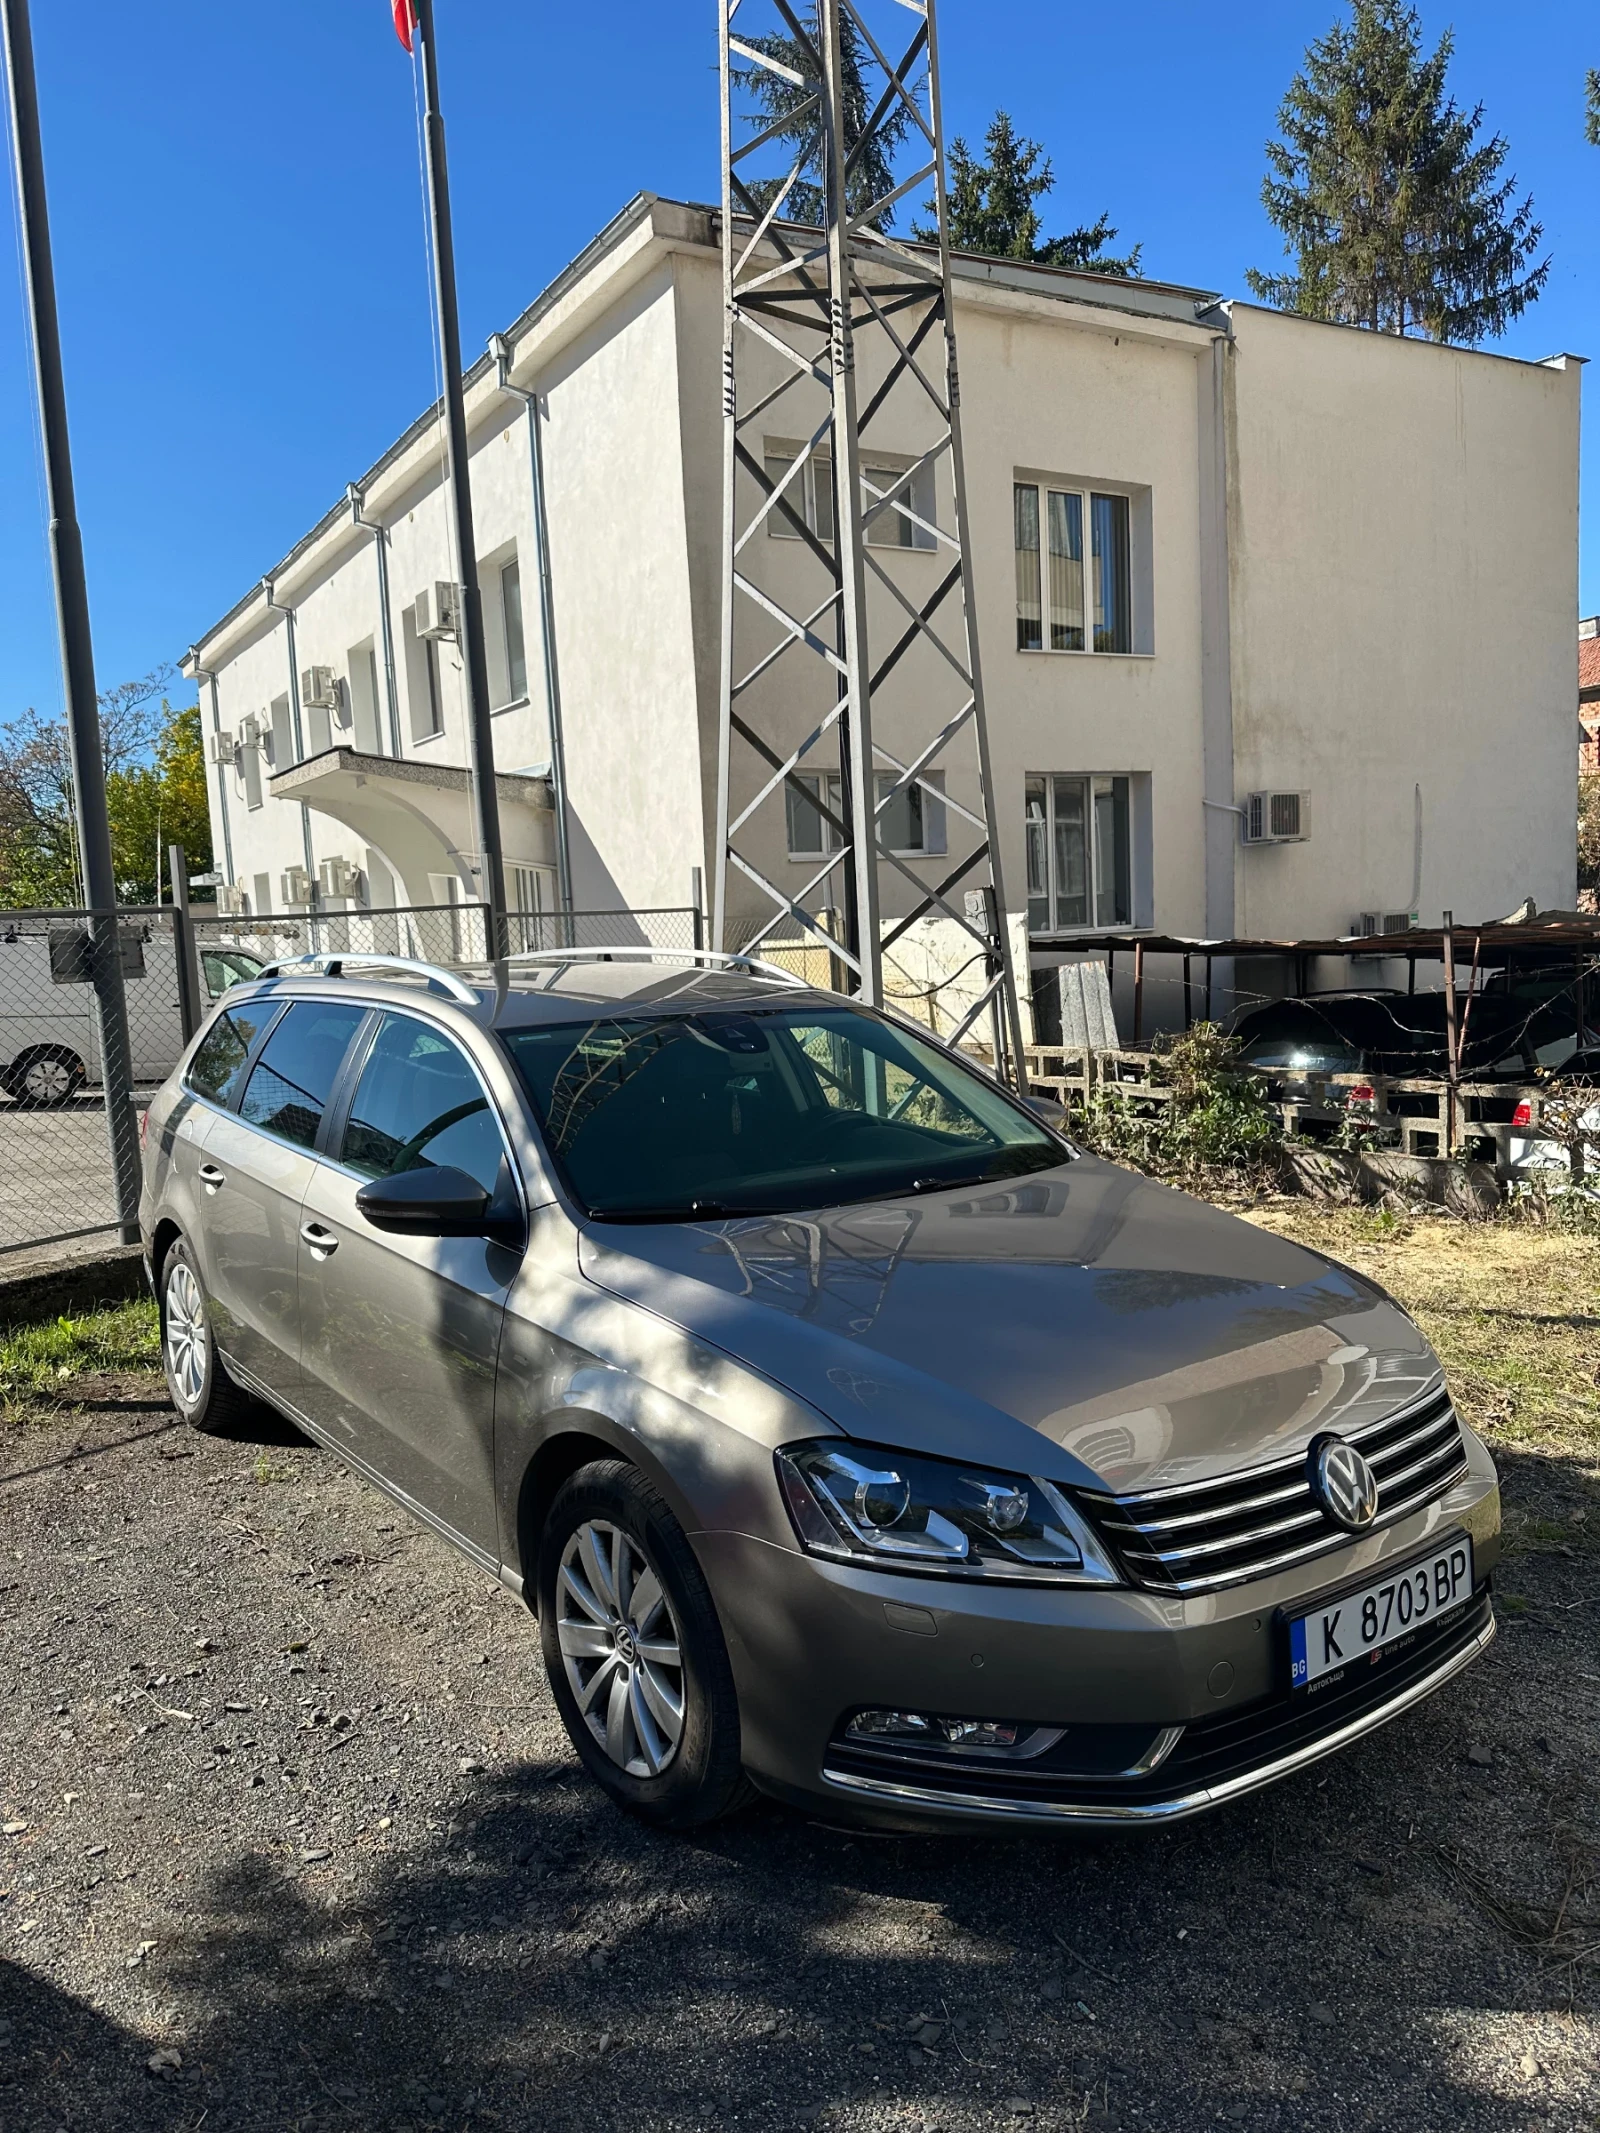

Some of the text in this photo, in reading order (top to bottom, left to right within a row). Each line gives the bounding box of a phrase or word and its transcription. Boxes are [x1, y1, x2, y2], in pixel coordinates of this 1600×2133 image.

[1322, 1608, 1344, 1665] K
[1292, 1660, 1306, 1679] BG
[1307, 1670, 1345, 1694] Автокъща
